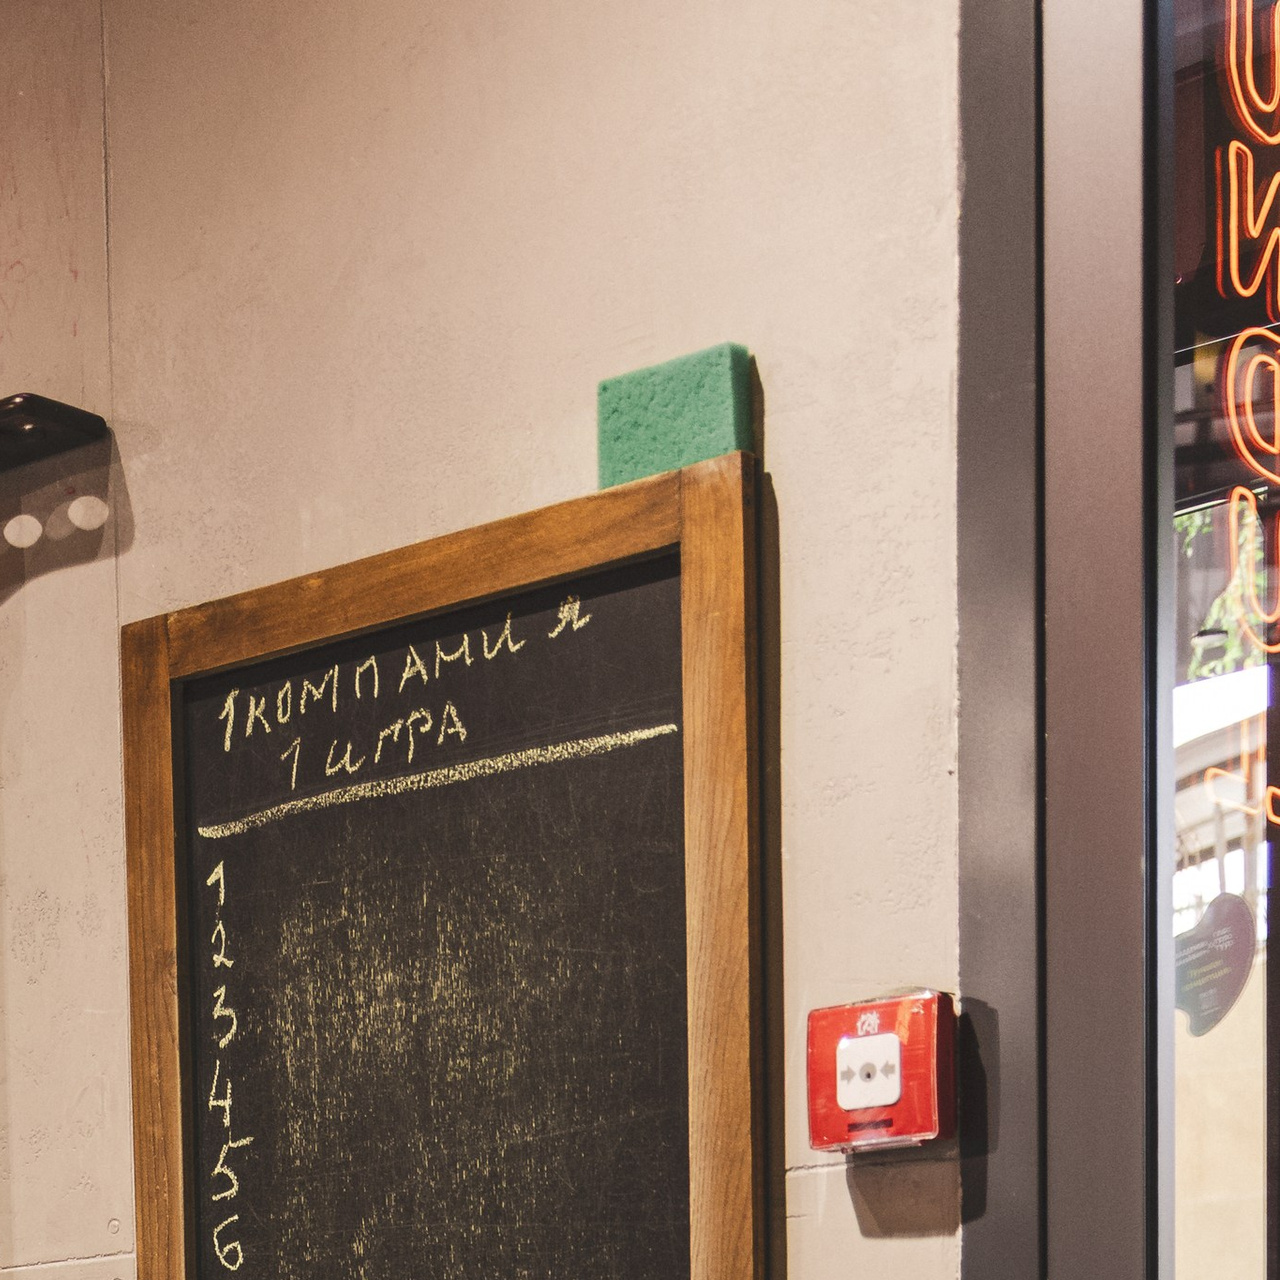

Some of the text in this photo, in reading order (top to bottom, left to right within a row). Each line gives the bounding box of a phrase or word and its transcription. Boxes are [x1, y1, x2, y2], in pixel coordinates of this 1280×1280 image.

[206, 860, 225, 905] 1
[211, 923, 233, 967] 2
[212, 985, 238, 1049] 3
[208, 1060, 233, 1128] 4
[211, 1136, 255, 1202] 5
[212, 1213, 244, 1270] 6
